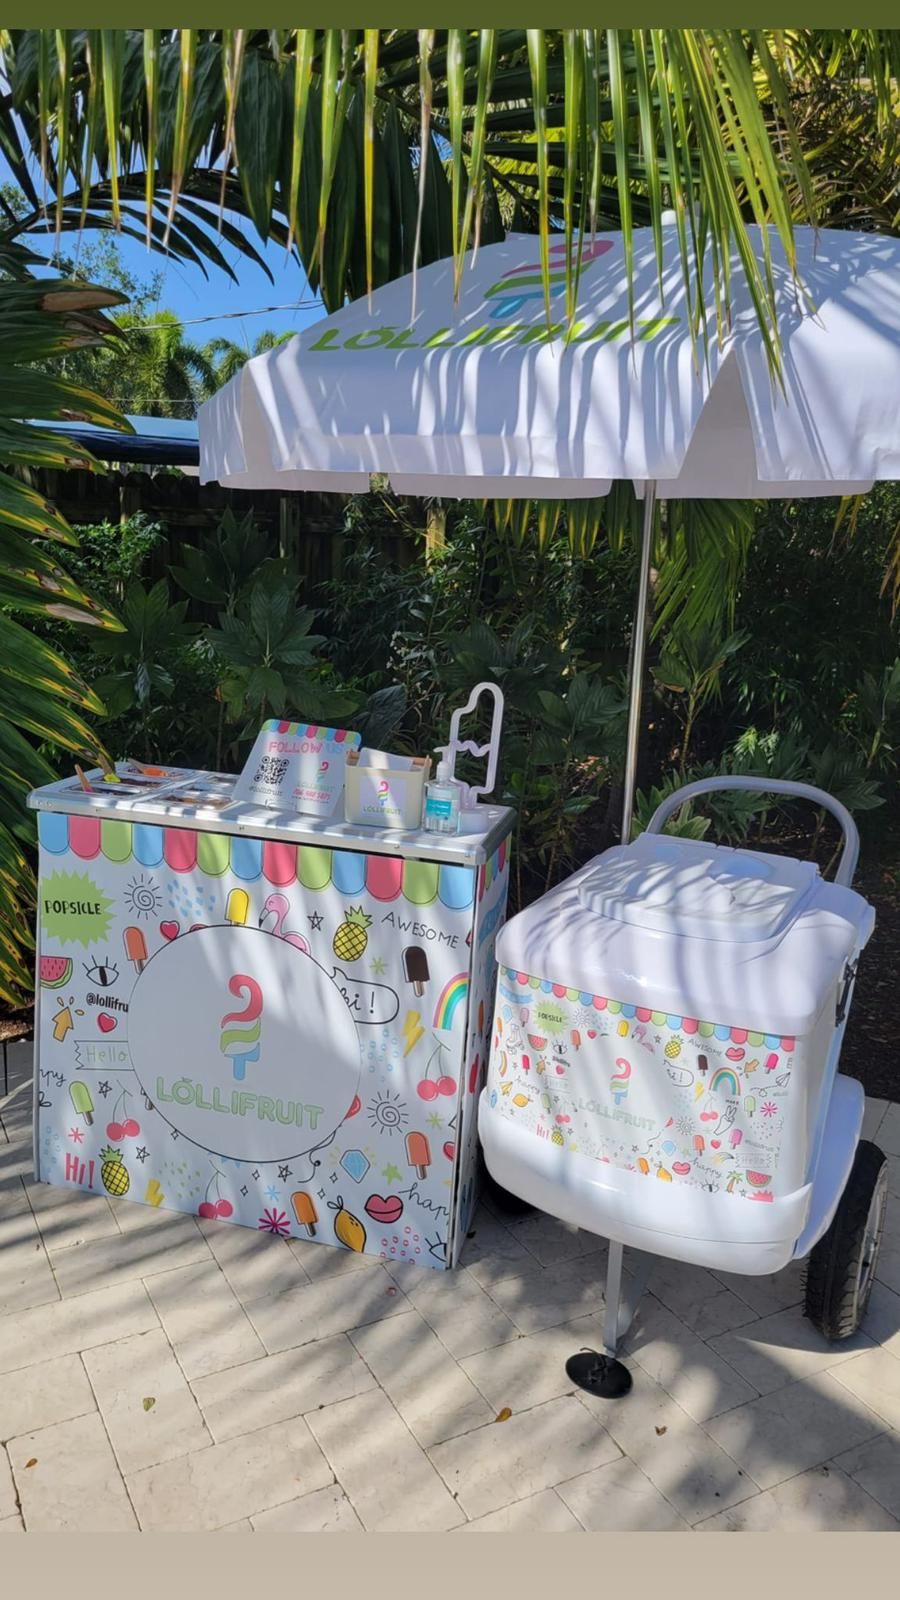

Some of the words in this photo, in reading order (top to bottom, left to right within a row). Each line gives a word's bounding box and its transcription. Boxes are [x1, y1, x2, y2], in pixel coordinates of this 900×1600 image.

[268, 740, 323, 754] FOLLOW
[44, 899, 102, 915] POPSICLE
[381, 911, 460, 949] AWESOME
[86, 1046, 128, 1063] Hello
[64, 1152, 95, 1189] Hi!
